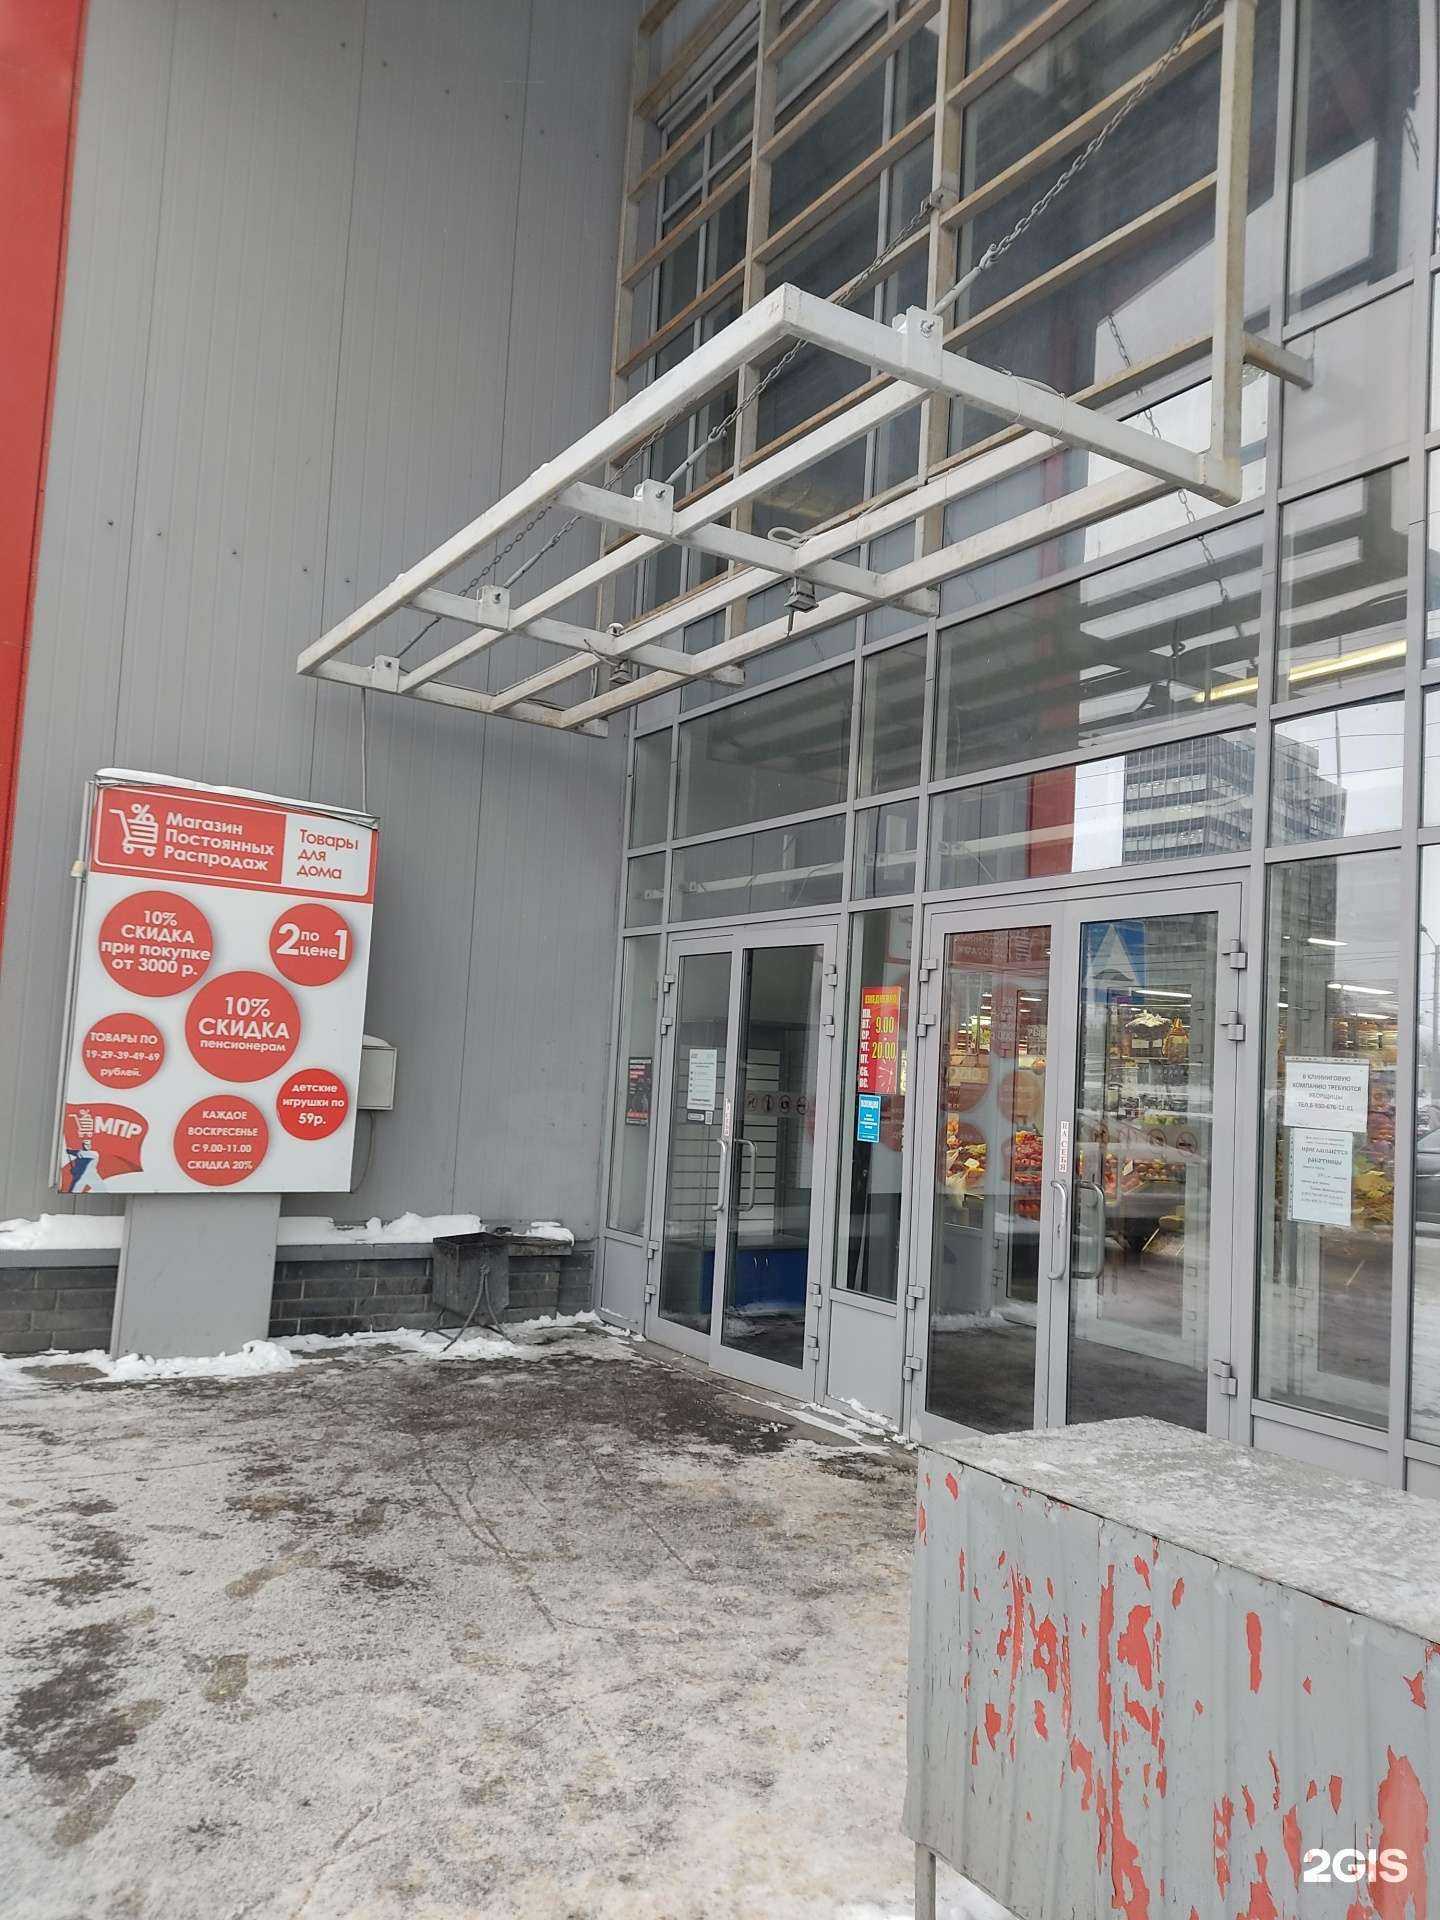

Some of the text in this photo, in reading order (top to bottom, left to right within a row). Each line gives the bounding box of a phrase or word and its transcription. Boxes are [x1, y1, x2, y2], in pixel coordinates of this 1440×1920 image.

[166, 812, 243, 836] Магазин
[164, 829, 275, 856] Постоянных
[299, 829, 359, 850] Товары
[164, 845, 268, 872] Распродаж
[298, 850, 327, 862] для
[296, 864, 342, 880] дома
[143, 910, 178, 927] 10%
[121, 924, 195, 944] СКИДКА
[276, 922, 320, 956] 2 по
[101, 941, 212, 961] при покупке
[300, 929, 348, 961] цене 1
[111, 957, 198, 977] от 3000 р.
[225, 996, 271, 1017] 10%
[199, 1017, 290, 1040] СКИДКА
[875, 1016, 895, 1033] 9.00
[90, 1032, 158, 1044] ТОВАРЫ ПО
[200, 1039, 286, 1053] пенсионерам
[86, 1049, 160, 1061] 19-29-39-49-69
[292, 1084, 338, 1093] детские
[282, 1098, 345, 1107] игрушки по
[202, 1110, 248, 1121] КАЖДОЕ
[298, 1113, 327, 1125] 59р.
[94, 1116, 142, 1139] МПР
[187, 1126, 259, 1137] ВОСКРЕСЕНЬЕ
[202, 1144, 252, 1153] 9.00-11.00
[187, 1160, 253, 1170] СКИДКА 20%
